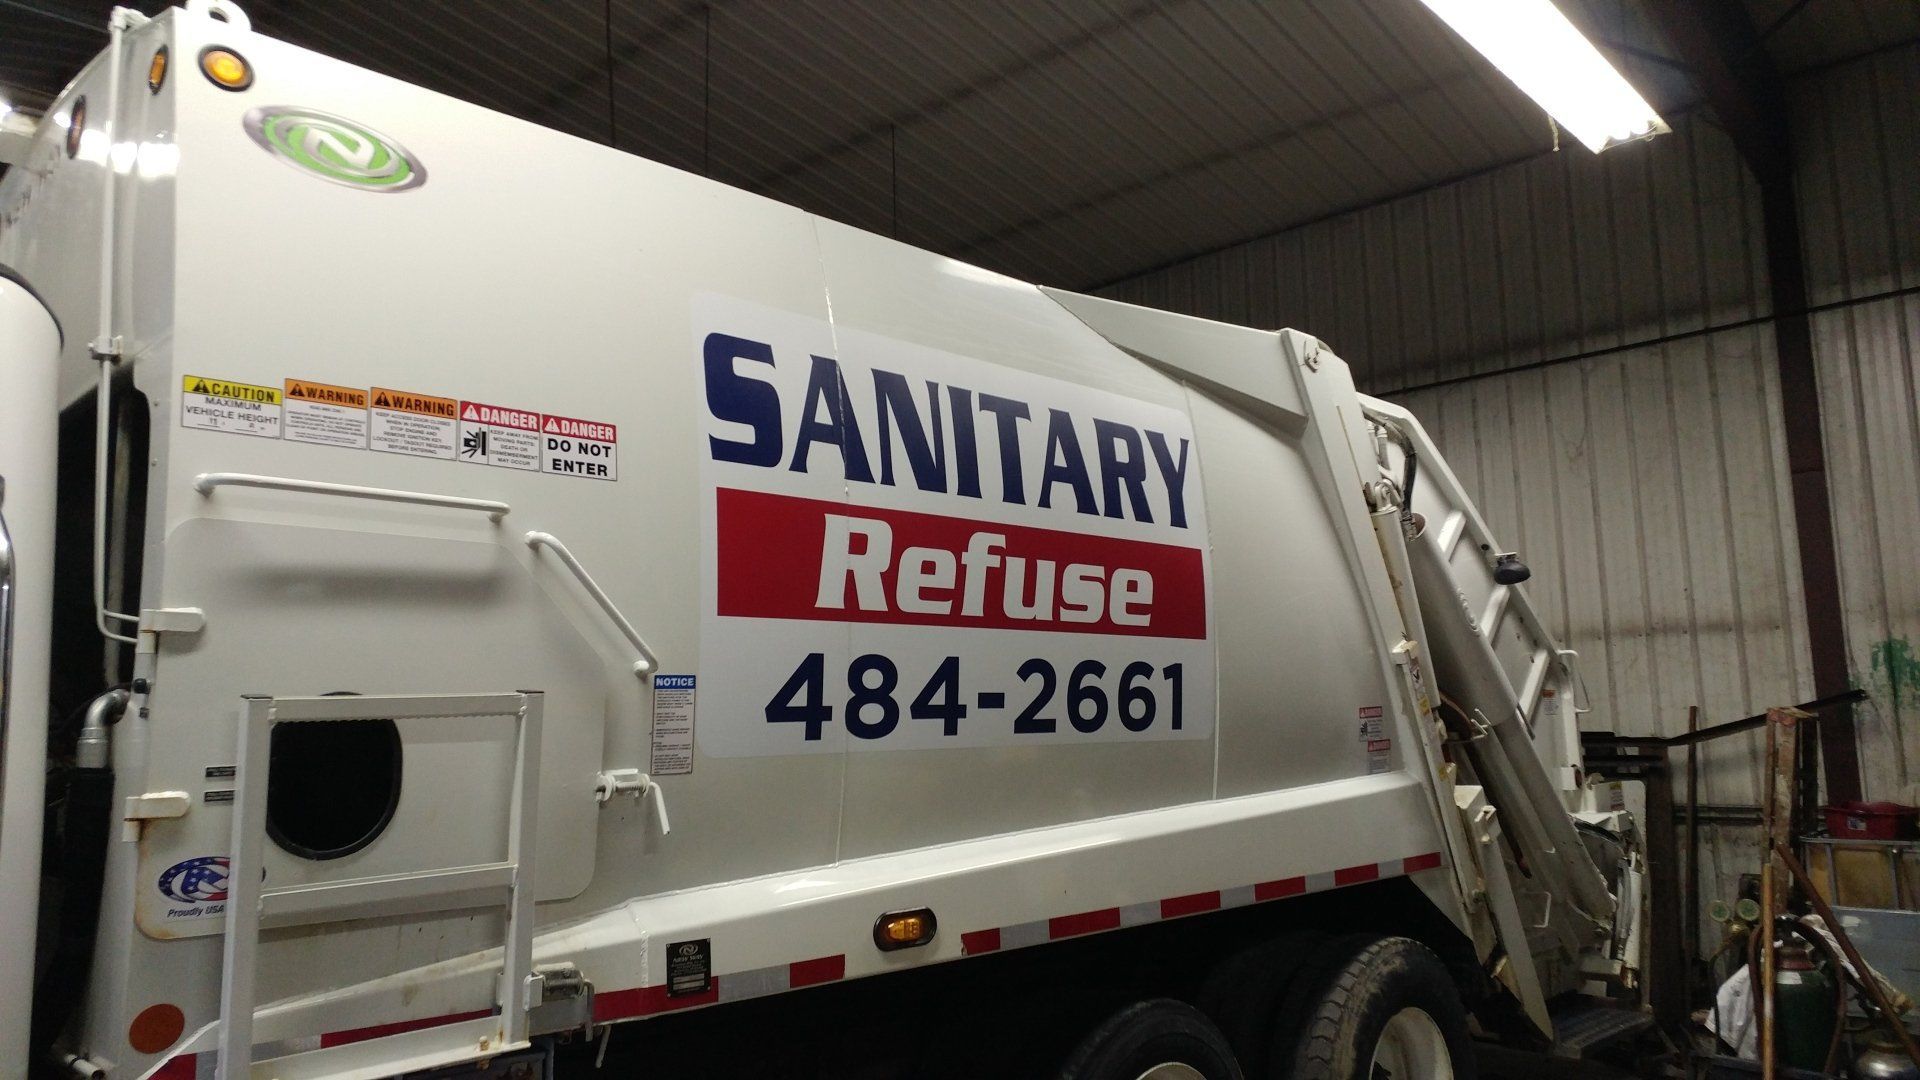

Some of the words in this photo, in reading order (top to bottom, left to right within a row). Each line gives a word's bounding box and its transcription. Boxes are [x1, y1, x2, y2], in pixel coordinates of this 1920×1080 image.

[212, 383, 275, 403] CAUTION
[306, 387, 364, 406] WARNING
[205, 396, 262, 411] MAXIMUM
[392, 395, 454, 416] WARNING
[186, 405, 234, 419] VEHICLE
[238, 412, 278, 425] HEIGHT
[480, 407, 538, 430] DANGER
[560, 421, 614, 441] DANGER
[703, 332, 1189, 529] SANITARY
[547, 438, 571, 453] DO
[578, 442, 611, 458] NOT
[552, 458, 608, 477] ENTER
[814, 513, 1154, 627] Refuse
[655, 677, 694, 687] NOTICE
[764, 653, 1183, 741] 484-2661
[167, 906, 204, 918] Proudly
[205, 905, 224, 915] USA
